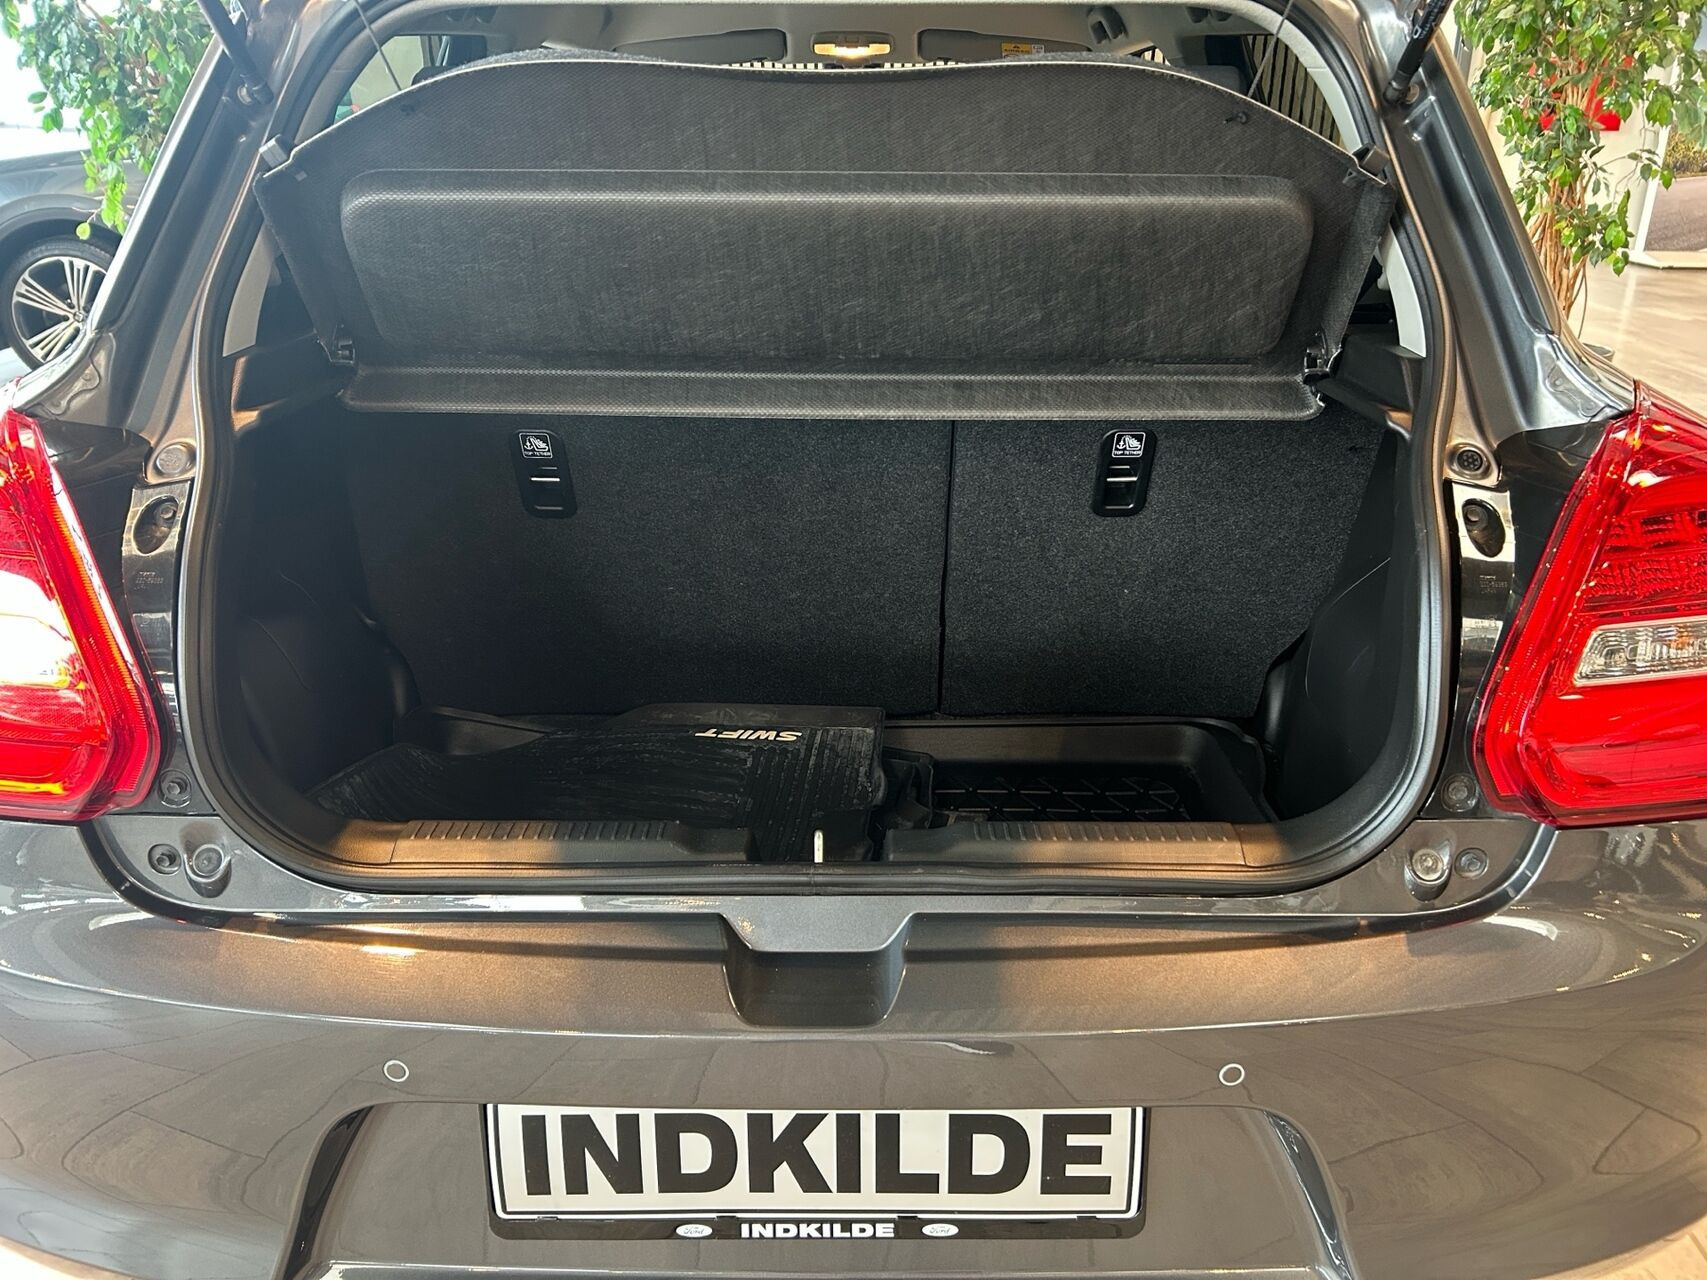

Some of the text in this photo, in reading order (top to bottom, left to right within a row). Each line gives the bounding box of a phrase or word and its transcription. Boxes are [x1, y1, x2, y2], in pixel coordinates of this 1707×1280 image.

[694, 728, 803, 742] SWIFT
[519, 1113, 1112, 1196] INDKILDE
[740, 1223, 895, 1239] INDKILDE
